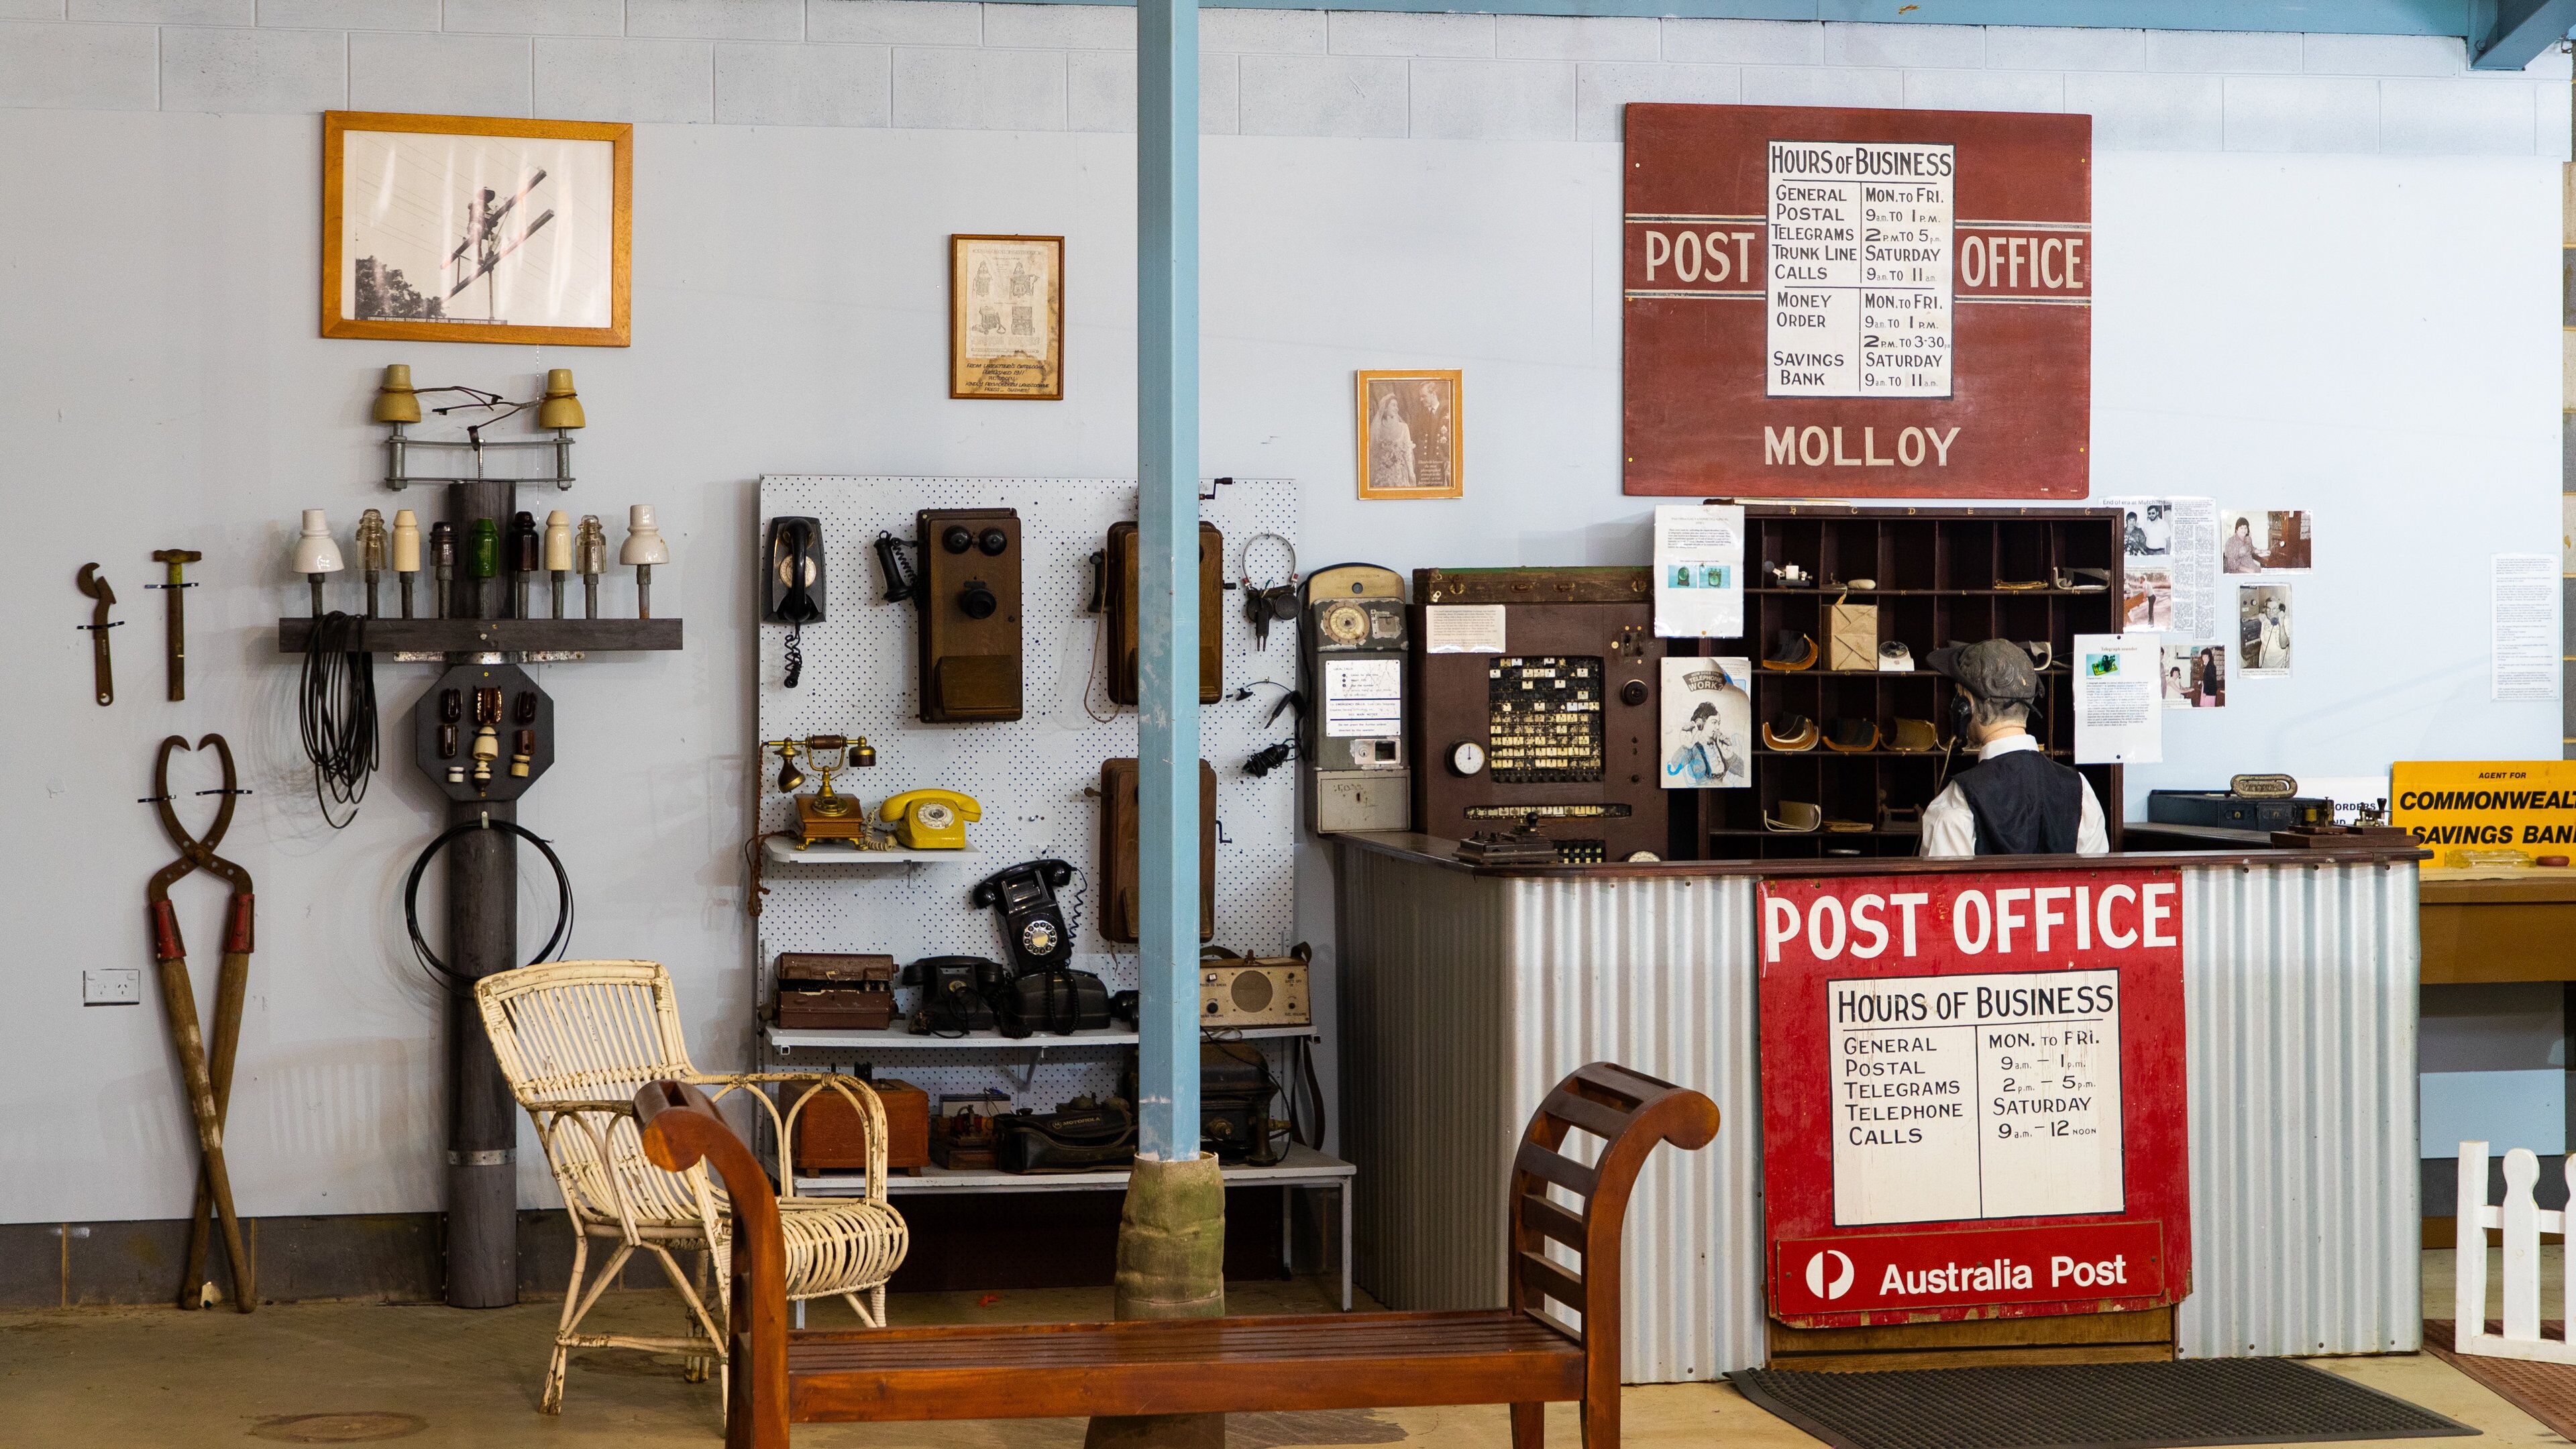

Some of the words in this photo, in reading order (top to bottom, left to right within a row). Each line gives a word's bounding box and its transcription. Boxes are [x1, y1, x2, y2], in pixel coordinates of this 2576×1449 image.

[1772, 146, 1833, 173] HOURS
[1835, 156, 1854, 174] OF
[1856, 148, 1951, 176] BUSINESS
[1776, 184, 1847, 201] GENERAL
[1866, 187, 1898, 202] MON.
[1898, 193, 1913, 203] TO
[1917, 188, 1944, 203] FRI.
[1776, 203, 1844, 221] POSTAL
[1889, 211, 1902, 221] TO
[1771, 223, 1854, 241] TELEGRAMS
[1899, 231, 1913, 241] TO
[1646, 230, 1755, 282] POST
[1772, 244, 1819, 260] TRUNK
[1825, 246, 1857, 261] LINE
[1865, 245, 1941, 262] SATURDAY
[1962, 235, 2084, 288] OFFICE
[1775, 264, 1827, 280] CALLS
[1889, 270, 1903, 281] TO
[1777, 292, 1832, 307] MONEY
[1866, 293, 1898, 309] MON.
[1898, 299, 1911, 309] TO
[1915, 294, 1943, 309] FRI.
[1776, 312, 1825, 327] ORDER
[1888, 319, 1900, 328] TO
[1899, 339, 1911, 347] TO
[1774, 351, 1844, 366] SAVINGS
[1866, 352, 1943, 367] SATURDAY
[1781, 370, 1825, 385] BANK
[1888, 377, 1901, 386] TO
[1764, 425, 1962, 467] MOLLOY
[1689, 675, 1723, 683] TELEPHONE
[2400, 791, 2576, 810] COMMONWEAL
[2412, 825, 2514, 845] SAVINGS
[2522, 825, 2576, 844] BAN
[1766, 892, 1928, 963] POST
[1953, 883, 2177, 955] OFFICE
[1839, 990, 1927, 1023] HOURS
[1936, 991, 1968, 1020] OF
[1977, 985, 2114, 1018] BUSINESS
[1844, 1036, 1937, 1055] GENERAL
[1989, 1033, 2035, 1049] MON.
[2041, 1036, 2057, 1046] TO
[1846, 1059, 1925, 1077] POSTAL
[1843, 1080, 1960, 1099] TELEGRAMS
[1845, 1104, 1963, 1121] TELEPHONE
[1993, 1097, 2092, 1116] SATURDAY
[1063, 1117, 1100, 1126] MOTOROLA
[1849, 1126, 1923, 1146] CALLS
[1879, 1258, 2033, 1296] Australia
[2051, 1254, 2127, 1288] Post
